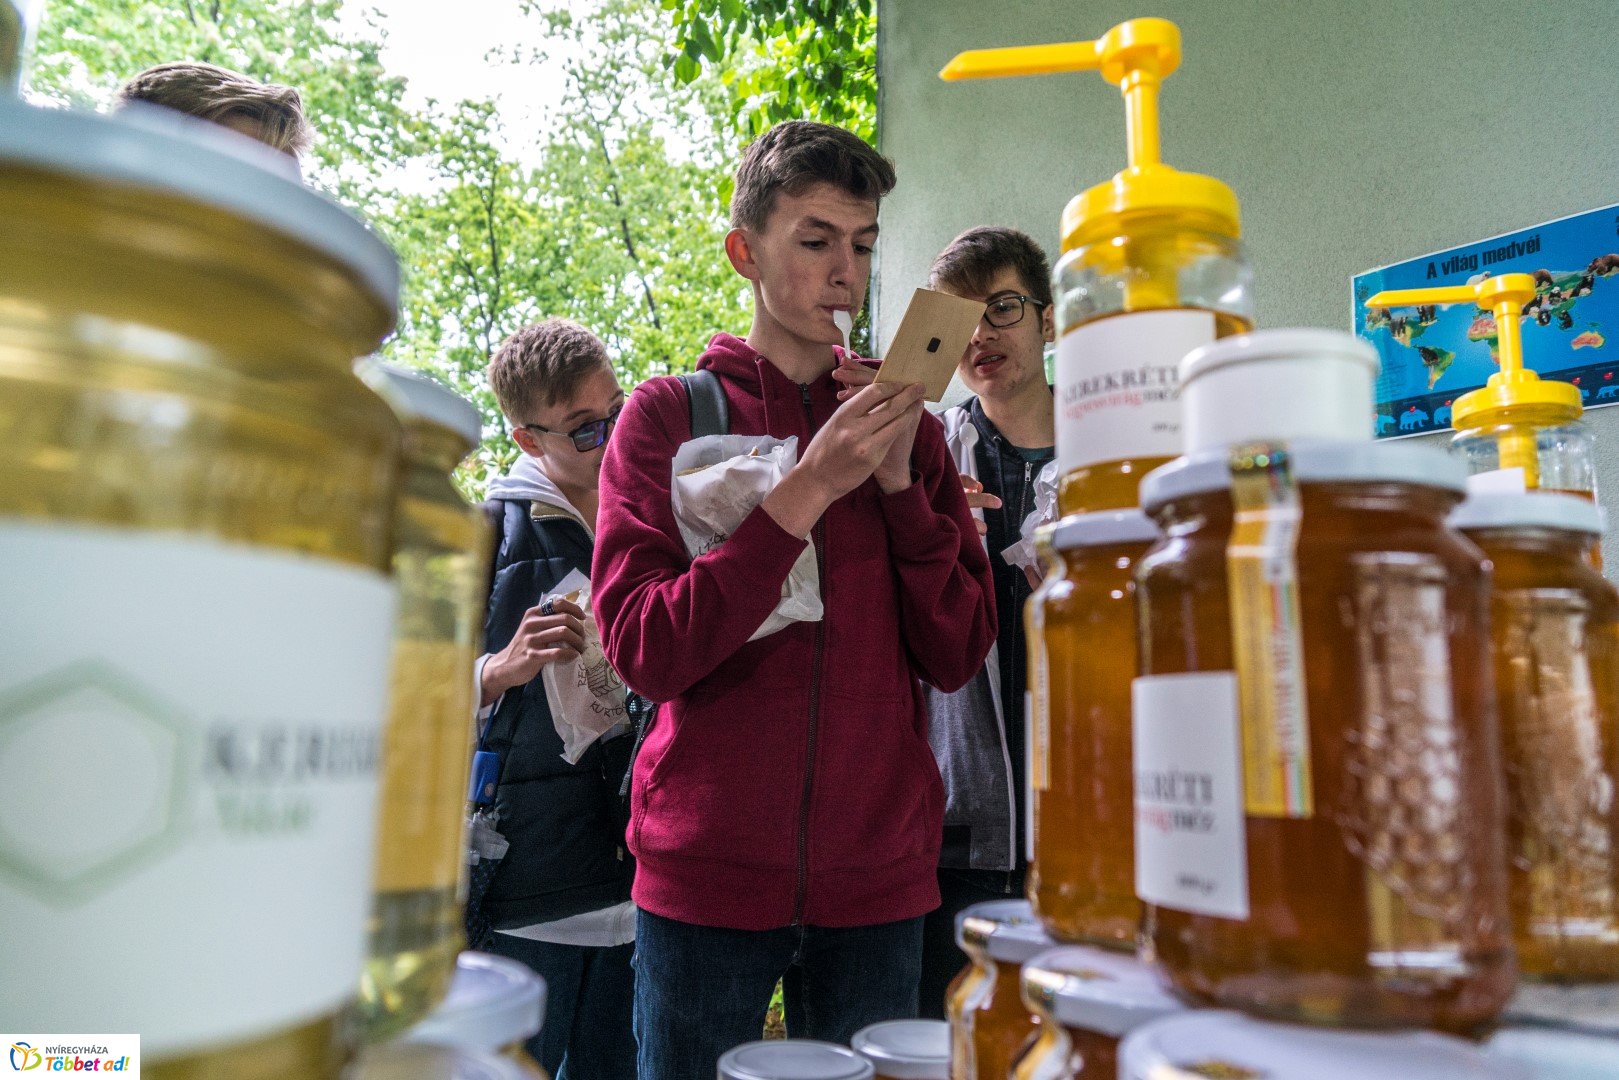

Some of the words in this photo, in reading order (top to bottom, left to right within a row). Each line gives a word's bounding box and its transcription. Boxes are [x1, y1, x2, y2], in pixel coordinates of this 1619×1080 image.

[1426, 262, 1437, 280] A
[1441, 253, 1478, 276] világ
[1482, 234, 1541, 266] medvéi
